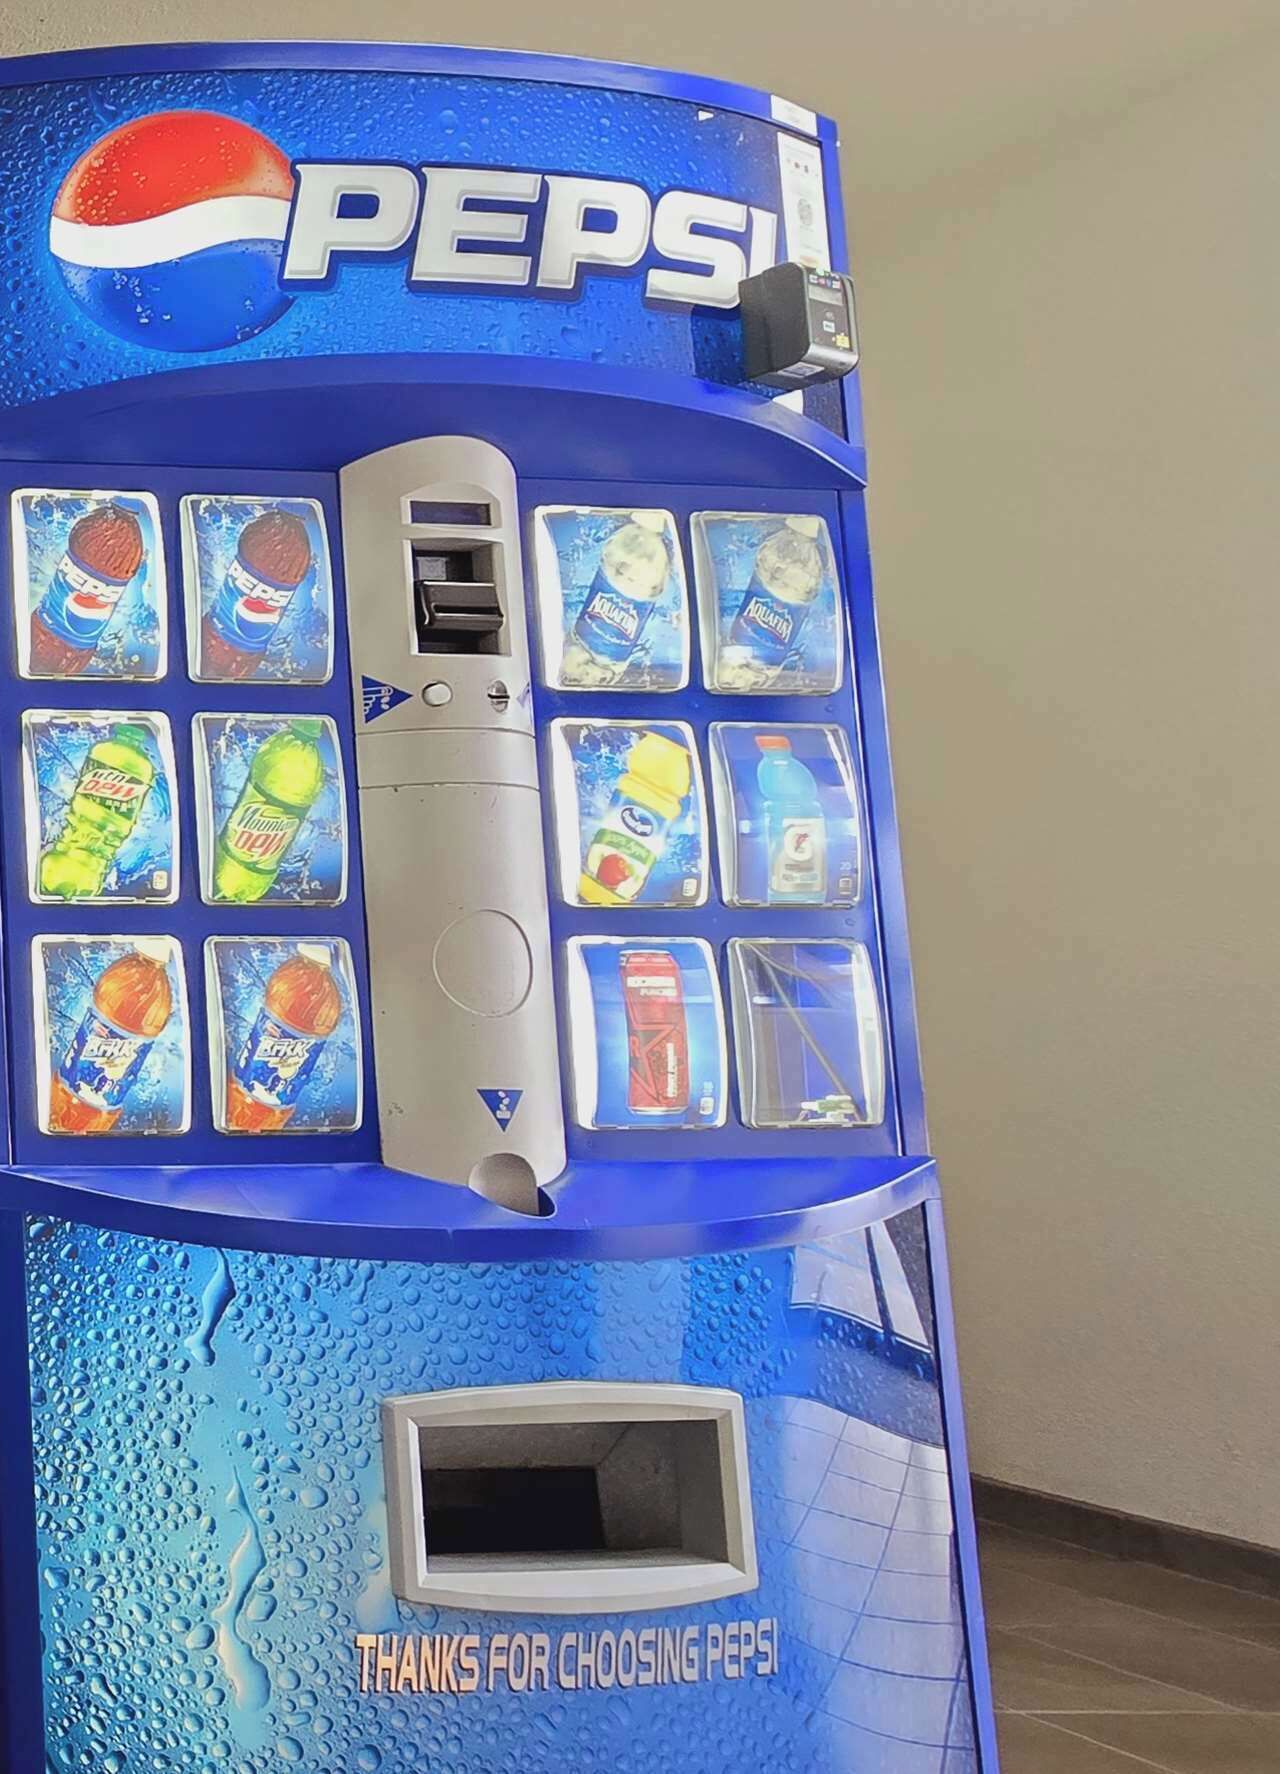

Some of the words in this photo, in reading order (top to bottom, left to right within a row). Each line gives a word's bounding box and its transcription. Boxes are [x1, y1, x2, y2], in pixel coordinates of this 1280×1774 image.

[282, 162, 778, 311] PEPSI
[58, 555, 126, 603] PEPS
[227, 558, 298, 606] PEPS
[355, 1631, 481, 1694] THANKS
[485, 1631, 550, 1692] FOR
[556, 1623, 701, 1691] CHOOSING
[704, 1616, 779, 1682] PEPSI
